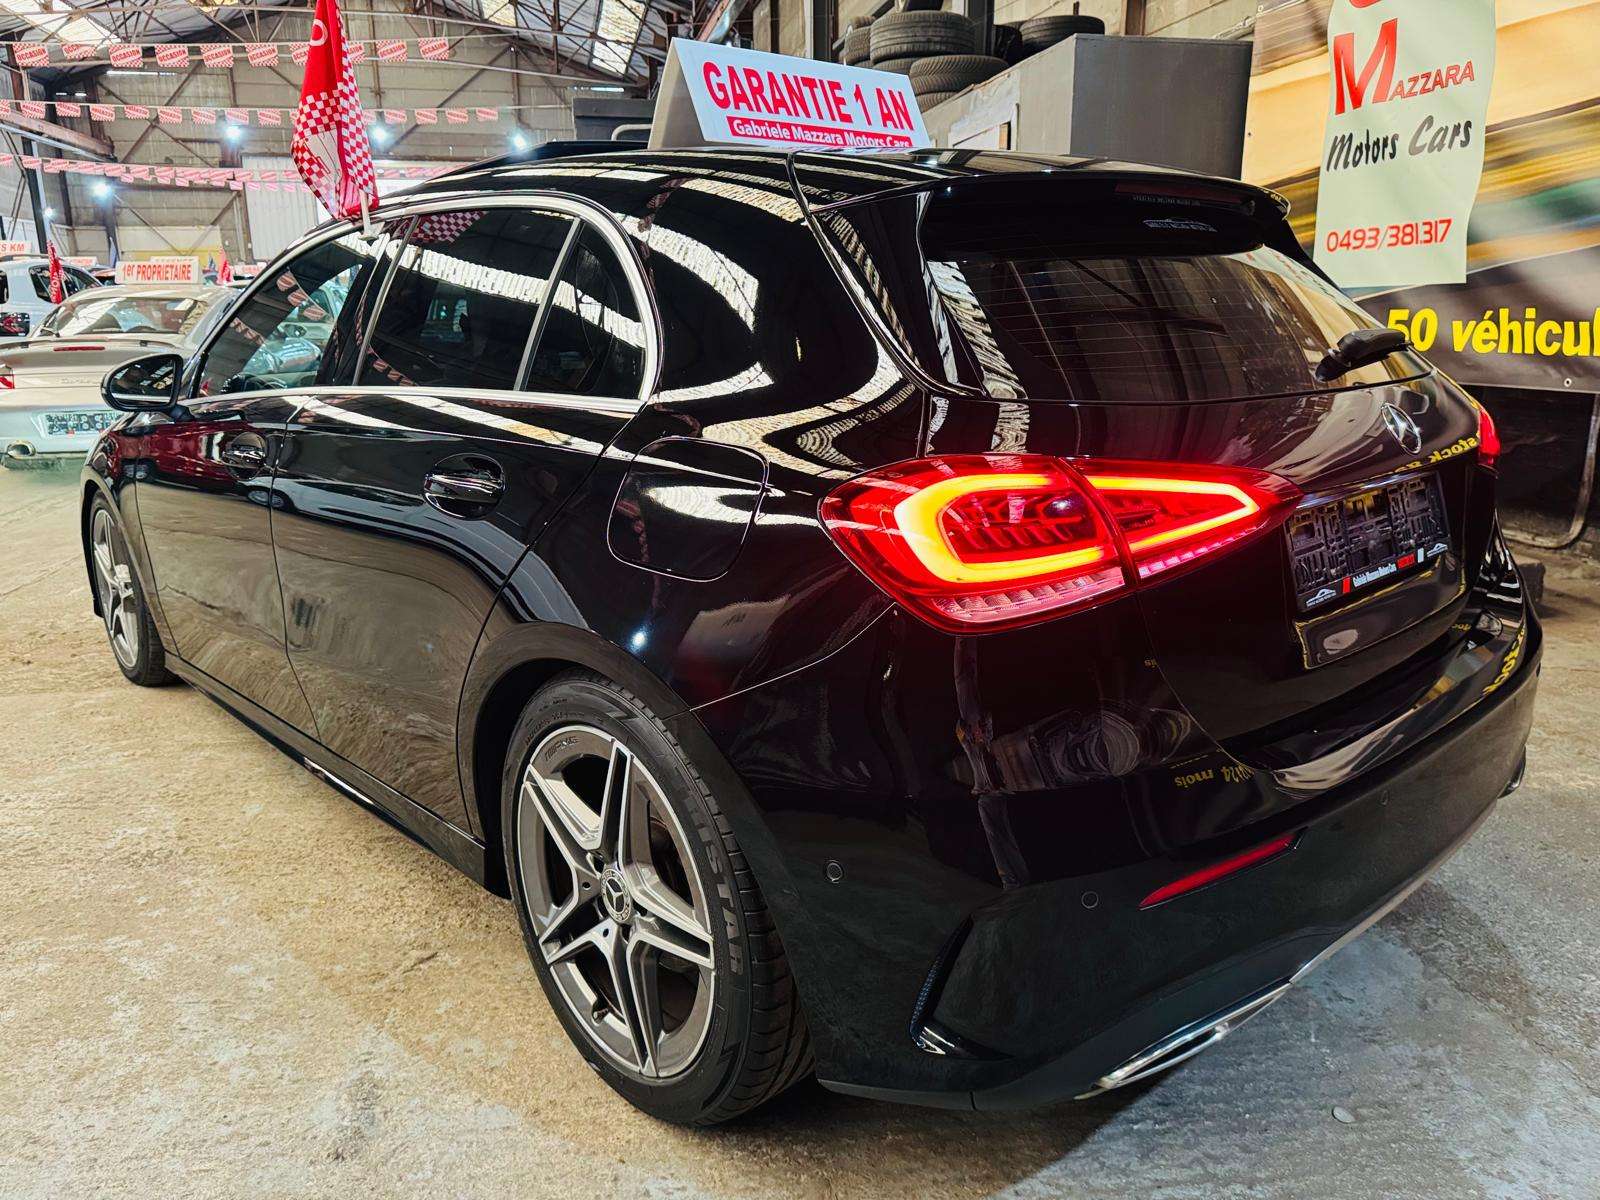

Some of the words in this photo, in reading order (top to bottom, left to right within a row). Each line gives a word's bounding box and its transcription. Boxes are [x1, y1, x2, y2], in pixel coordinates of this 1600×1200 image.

[1333, 17, 1475, 116] MAZZARA
[702, 61, 853, 124] GARANTIE
[854, 84, 872, 126] 1
[876, 87, 915, 131] AN
[733, 119, 790, 140] Gabriele
[792, 125, 844, 146] Mazzara
[845, 132, 886, 148] Motors
[1325, 129, 1400, 173] Motors
[1408, 114, 1473, 157] Cars
[10, 243, 25, 252] KM
[121, 264, 135, 281] 1er
[136, 263, 192, 281] PROPRIETAIRE
